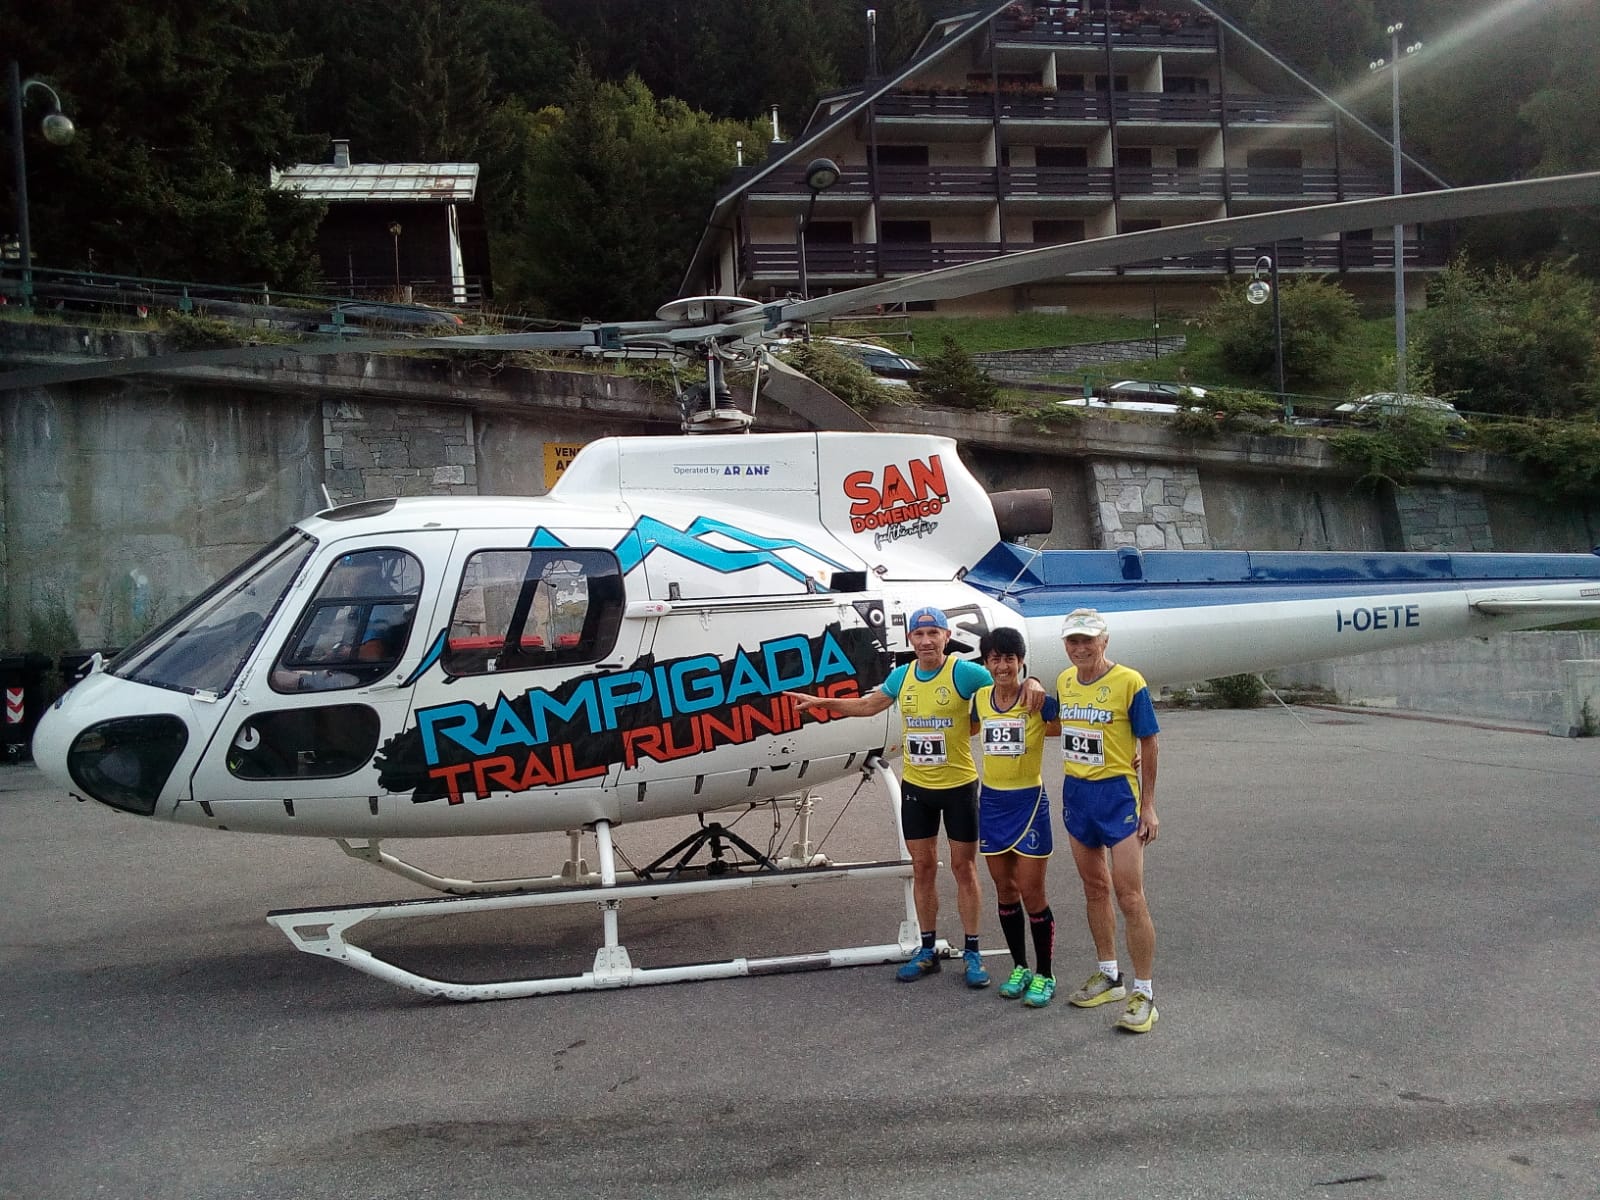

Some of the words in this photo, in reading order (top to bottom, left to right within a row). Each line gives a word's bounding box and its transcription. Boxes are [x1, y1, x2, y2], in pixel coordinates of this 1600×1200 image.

[673, 466, 709, 475] Operated
[710, 466, 720, 475] by
[844, 455, 948, 516] SAN
[850, 498, 942, 534] DOMENICO
[1336, 604, 1420, 632] I-OETE
[416, 630, 857, 765] RAMPIGADA
[906, 716, 953, 730] Technipes
[1060, 703, 1113, 724] Technipes
[992, 728, 1011, 742] 95
[1071, 736, 1090, 753] 94
[915, 741, 934, 755] 79
[428, 745, 606, 804] TRAIL
